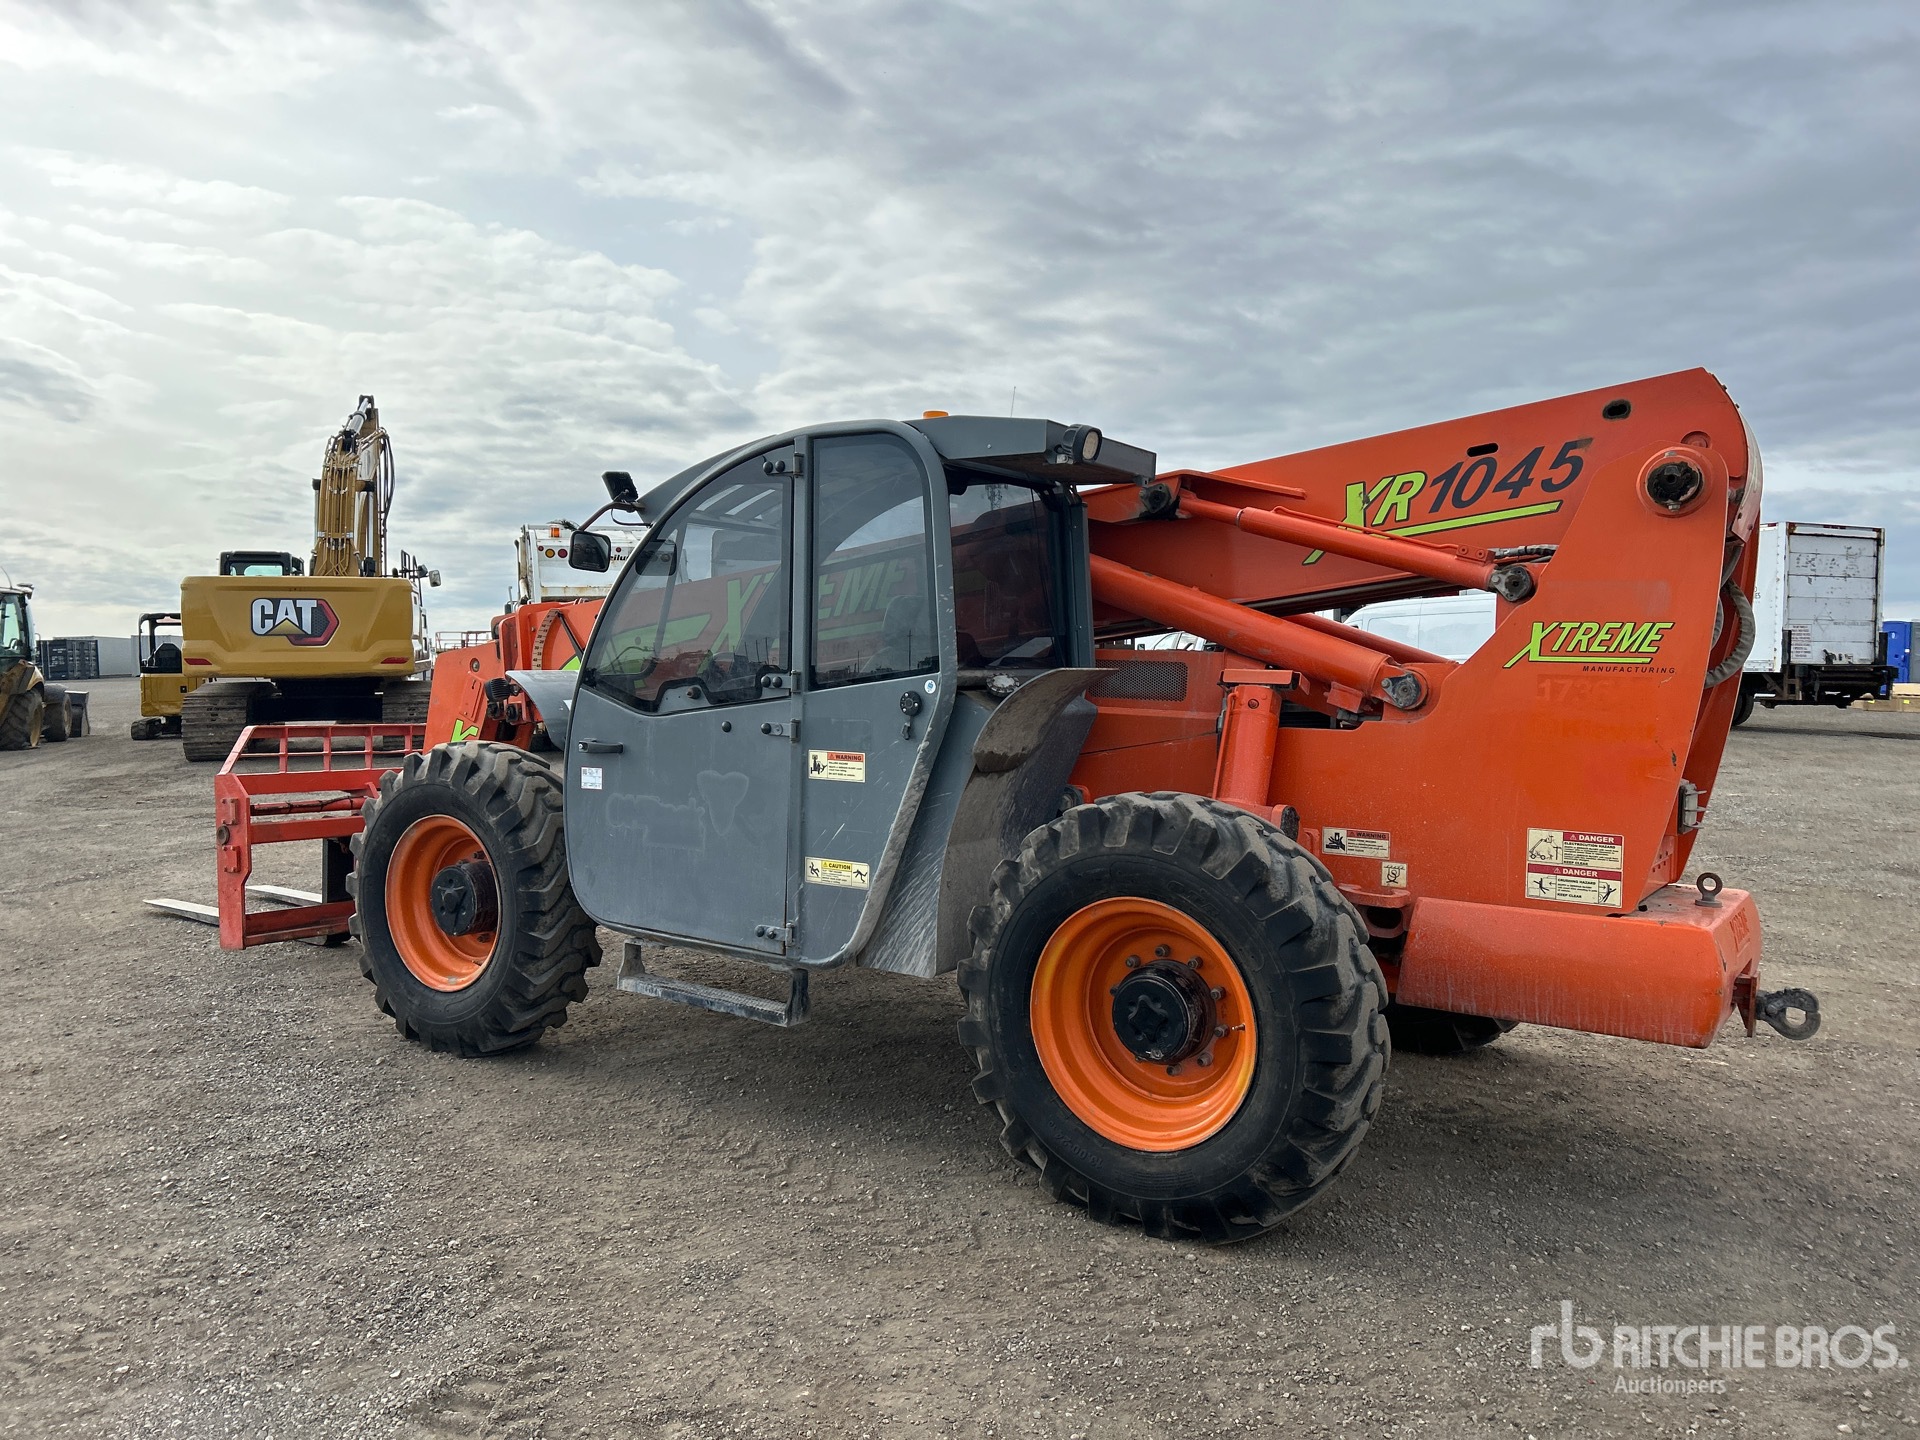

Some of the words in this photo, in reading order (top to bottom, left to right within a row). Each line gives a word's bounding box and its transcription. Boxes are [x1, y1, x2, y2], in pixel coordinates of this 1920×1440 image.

[252, 598, 317, 635] CAT
[1502, 621, 1676, 668] XTREME
[1582, 665, 1676, 674] MANUFACTURING
[1356, 832, 1387, 840] WARNING
[1578, 834, 1615, 844] DANGER
[1562, 868, 1598, 878] DANGER
